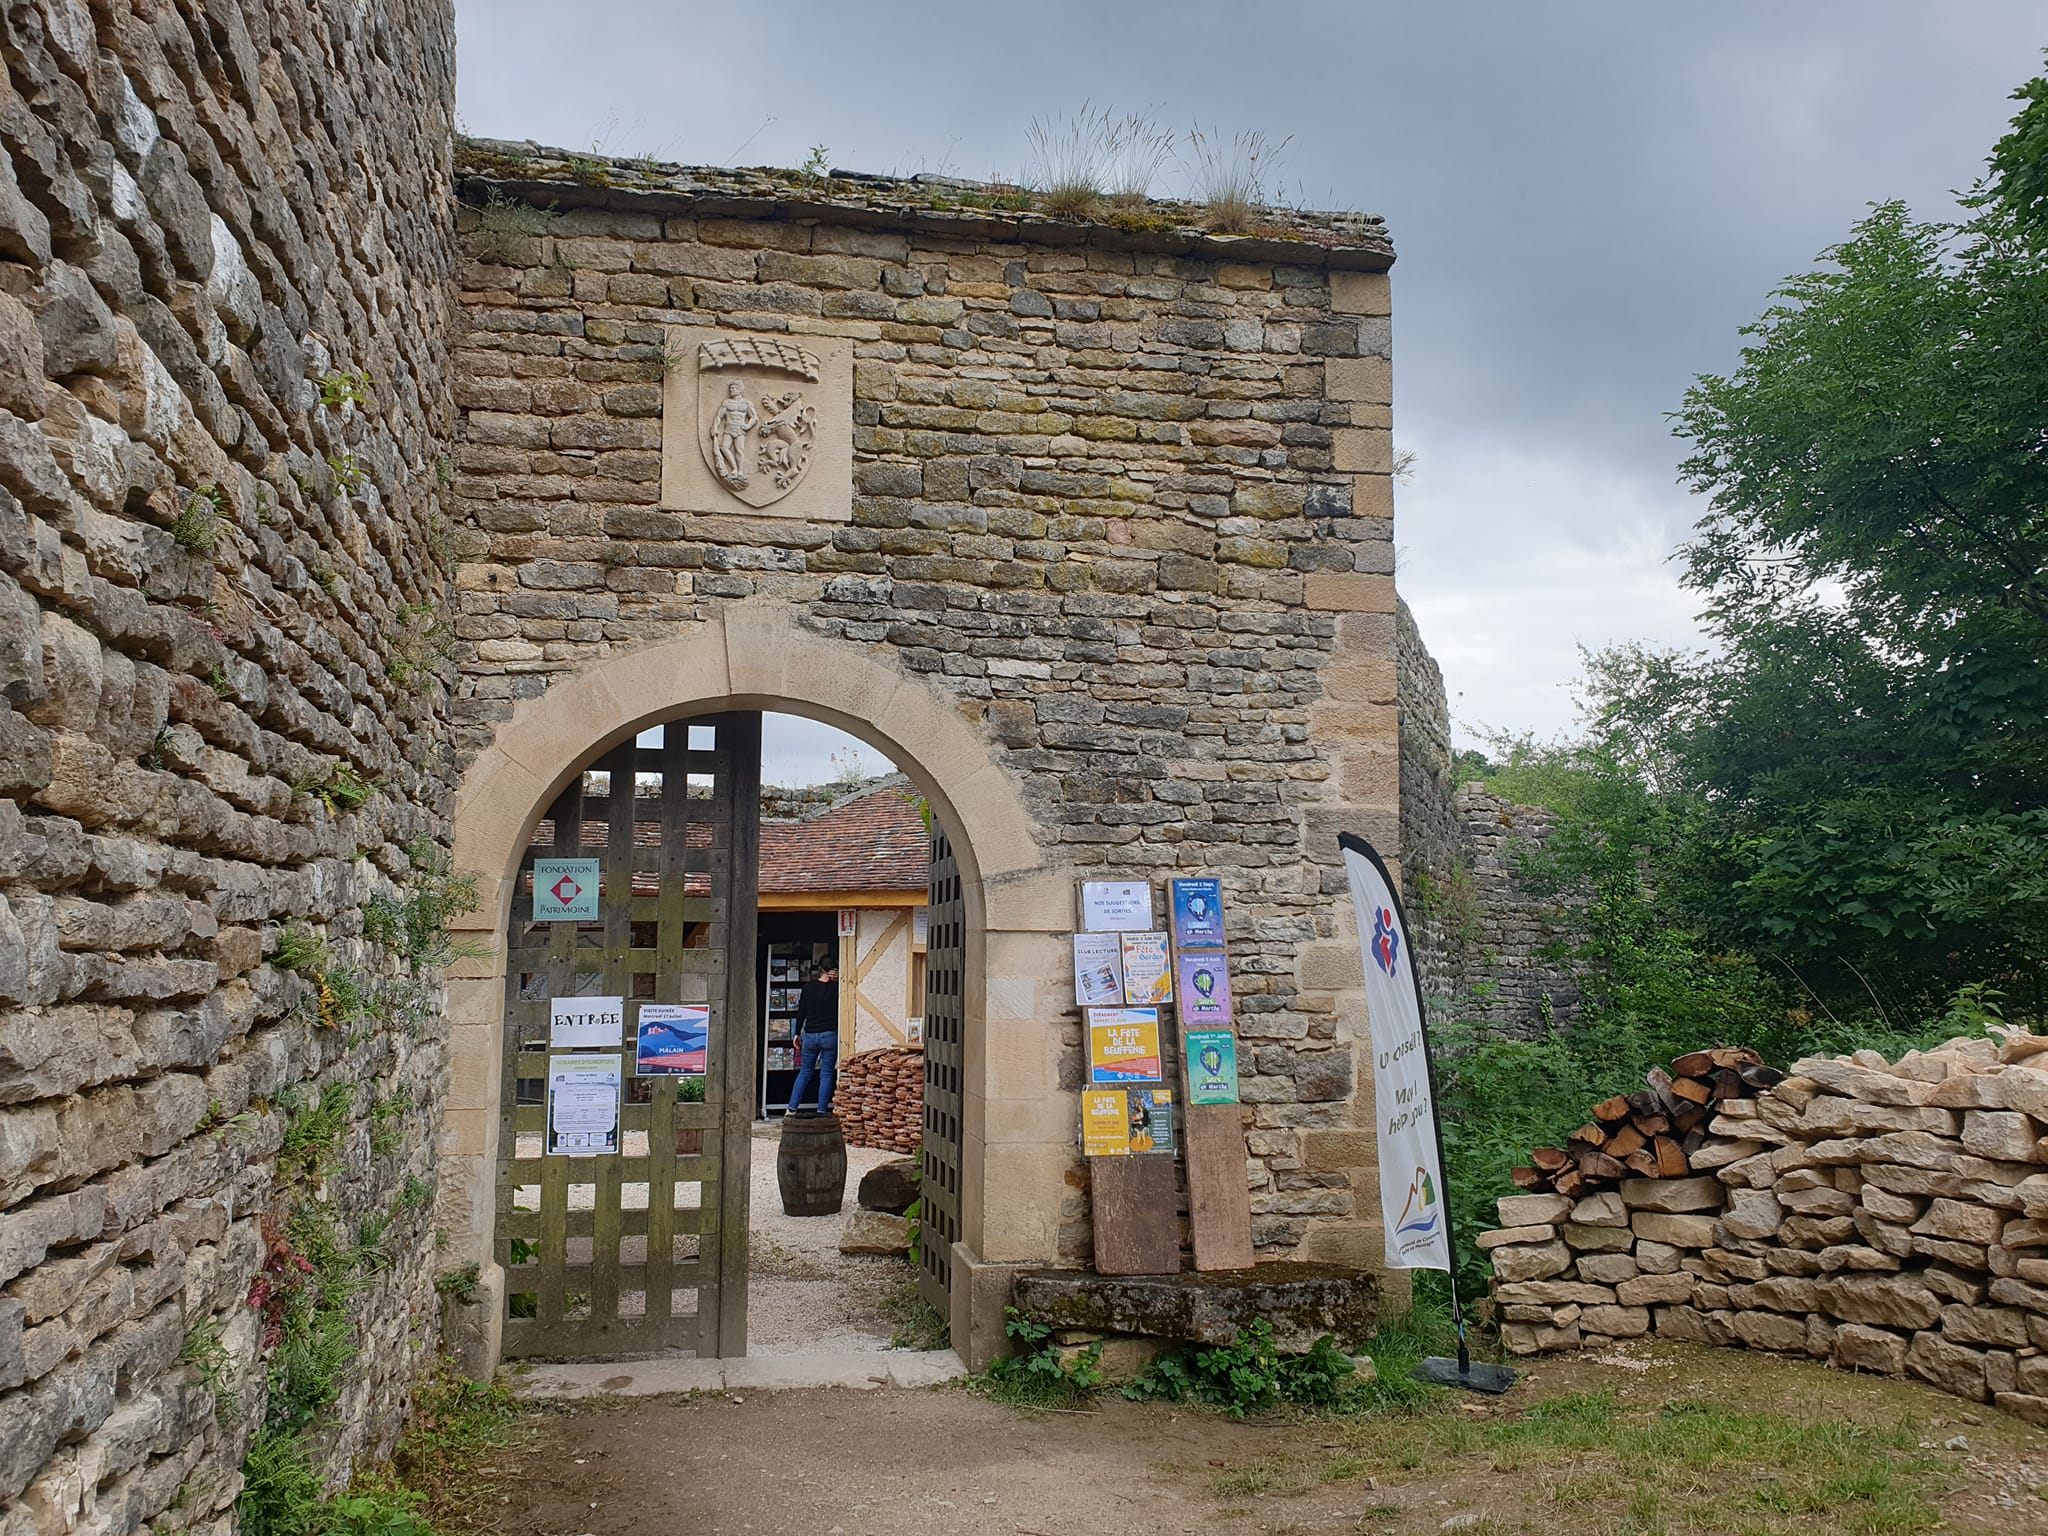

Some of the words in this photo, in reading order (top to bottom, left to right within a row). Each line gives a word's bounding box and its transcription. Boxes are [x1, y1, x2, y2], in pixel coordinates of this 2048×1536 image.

[541, 865, 592, 874] FONDATION
[540, 906, 592, 914] PATRIMOINE
[554, 1012, 620, 1027] ENTRÉE
[1107, 1028, 1118, 1037] LA
[1113, 1037, 1123, 1046] DE
[1126, 1037, 1137, 1046] LA
